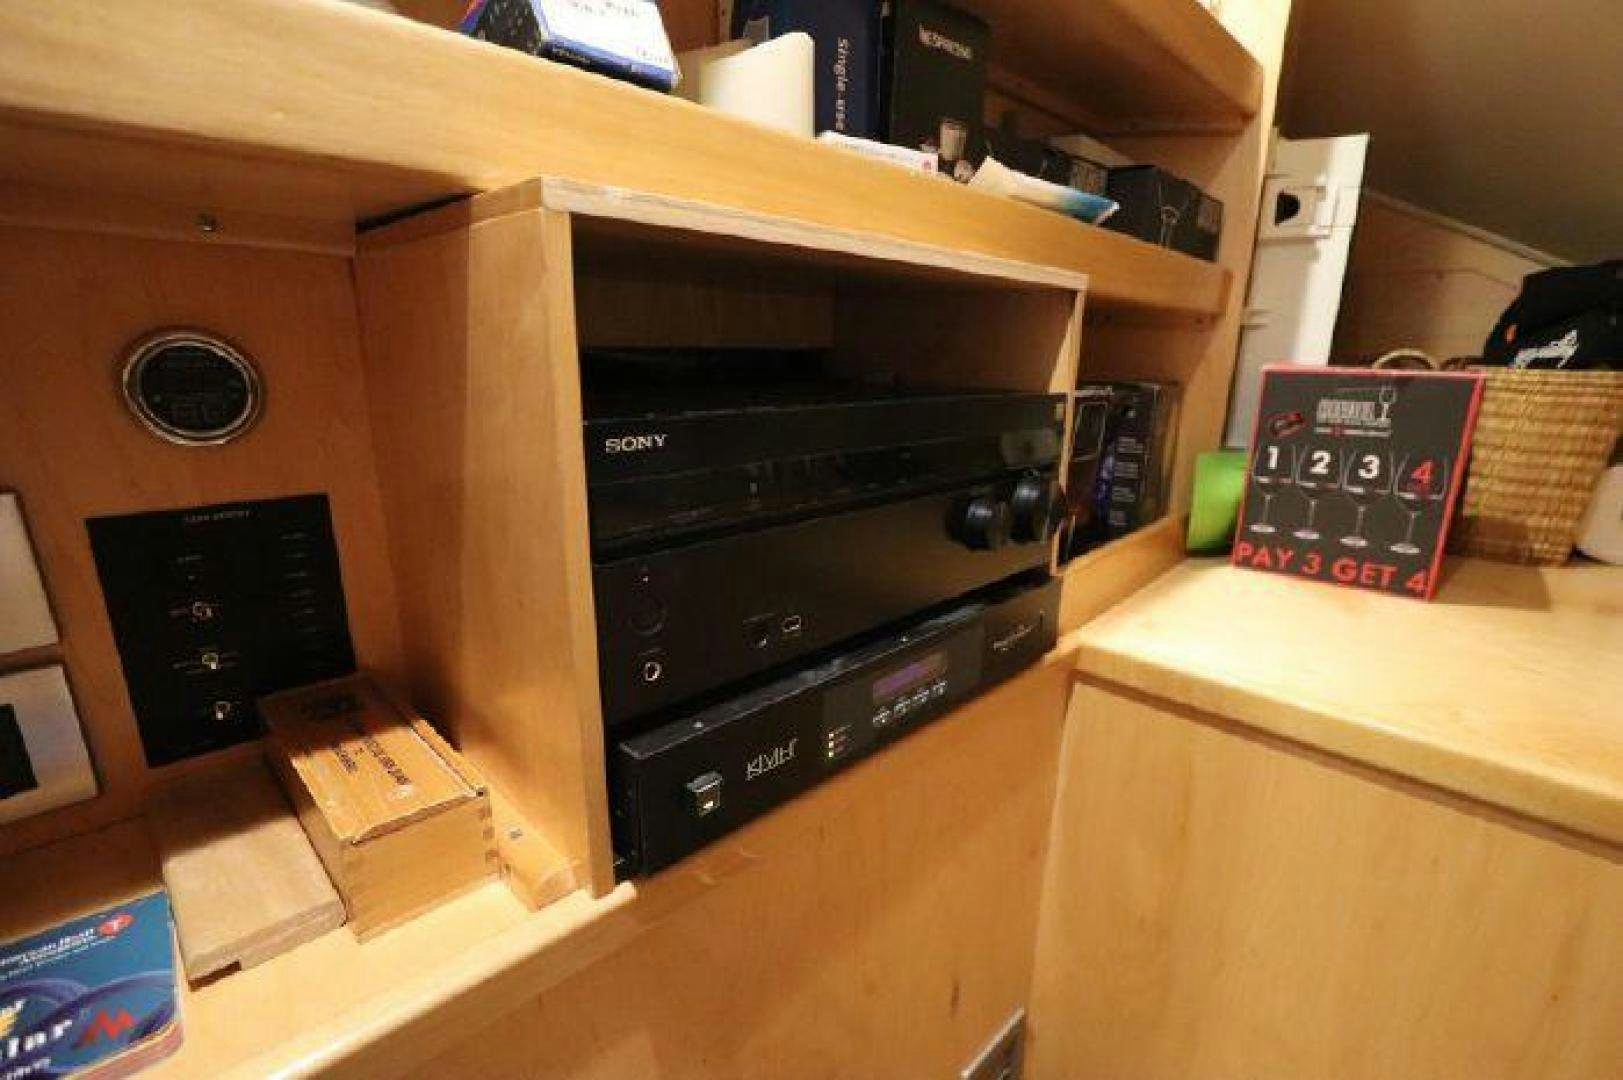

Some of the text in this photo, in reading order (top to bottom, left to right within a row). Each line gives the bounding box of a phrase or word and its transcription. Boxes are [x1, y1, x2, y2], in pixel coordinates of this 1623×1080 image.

[605, 433, 668, 454] SONY
[1267, 445, 1434, 485] 1 2 3 4
[1235, 542, 1427, 592] PAY 3 GET 4
